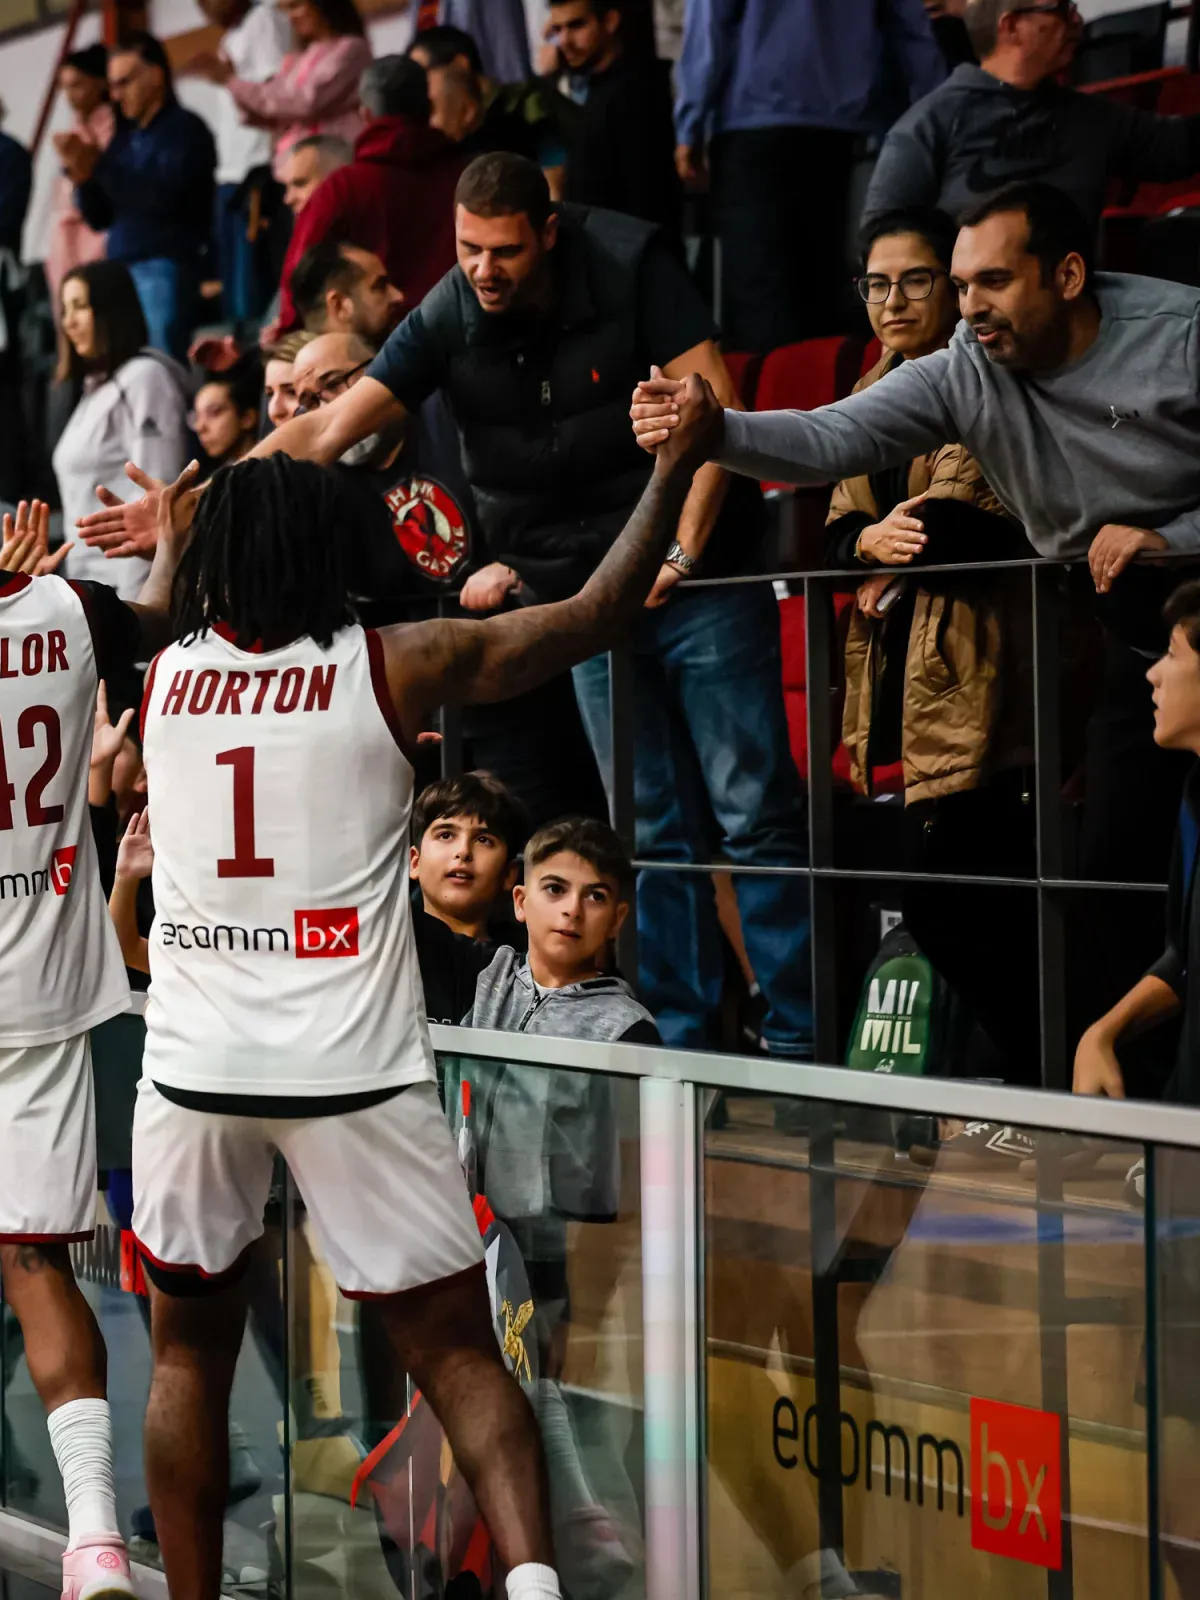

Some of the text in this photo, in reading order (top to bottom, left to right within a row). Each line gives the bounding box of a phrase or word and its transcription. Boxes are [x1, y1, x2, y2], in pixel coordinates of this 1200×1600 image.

[160, 663, 338, 716] HORTON
[215, 746, 275, 878] 1
[160, 917, 352, 952] ecommbx
